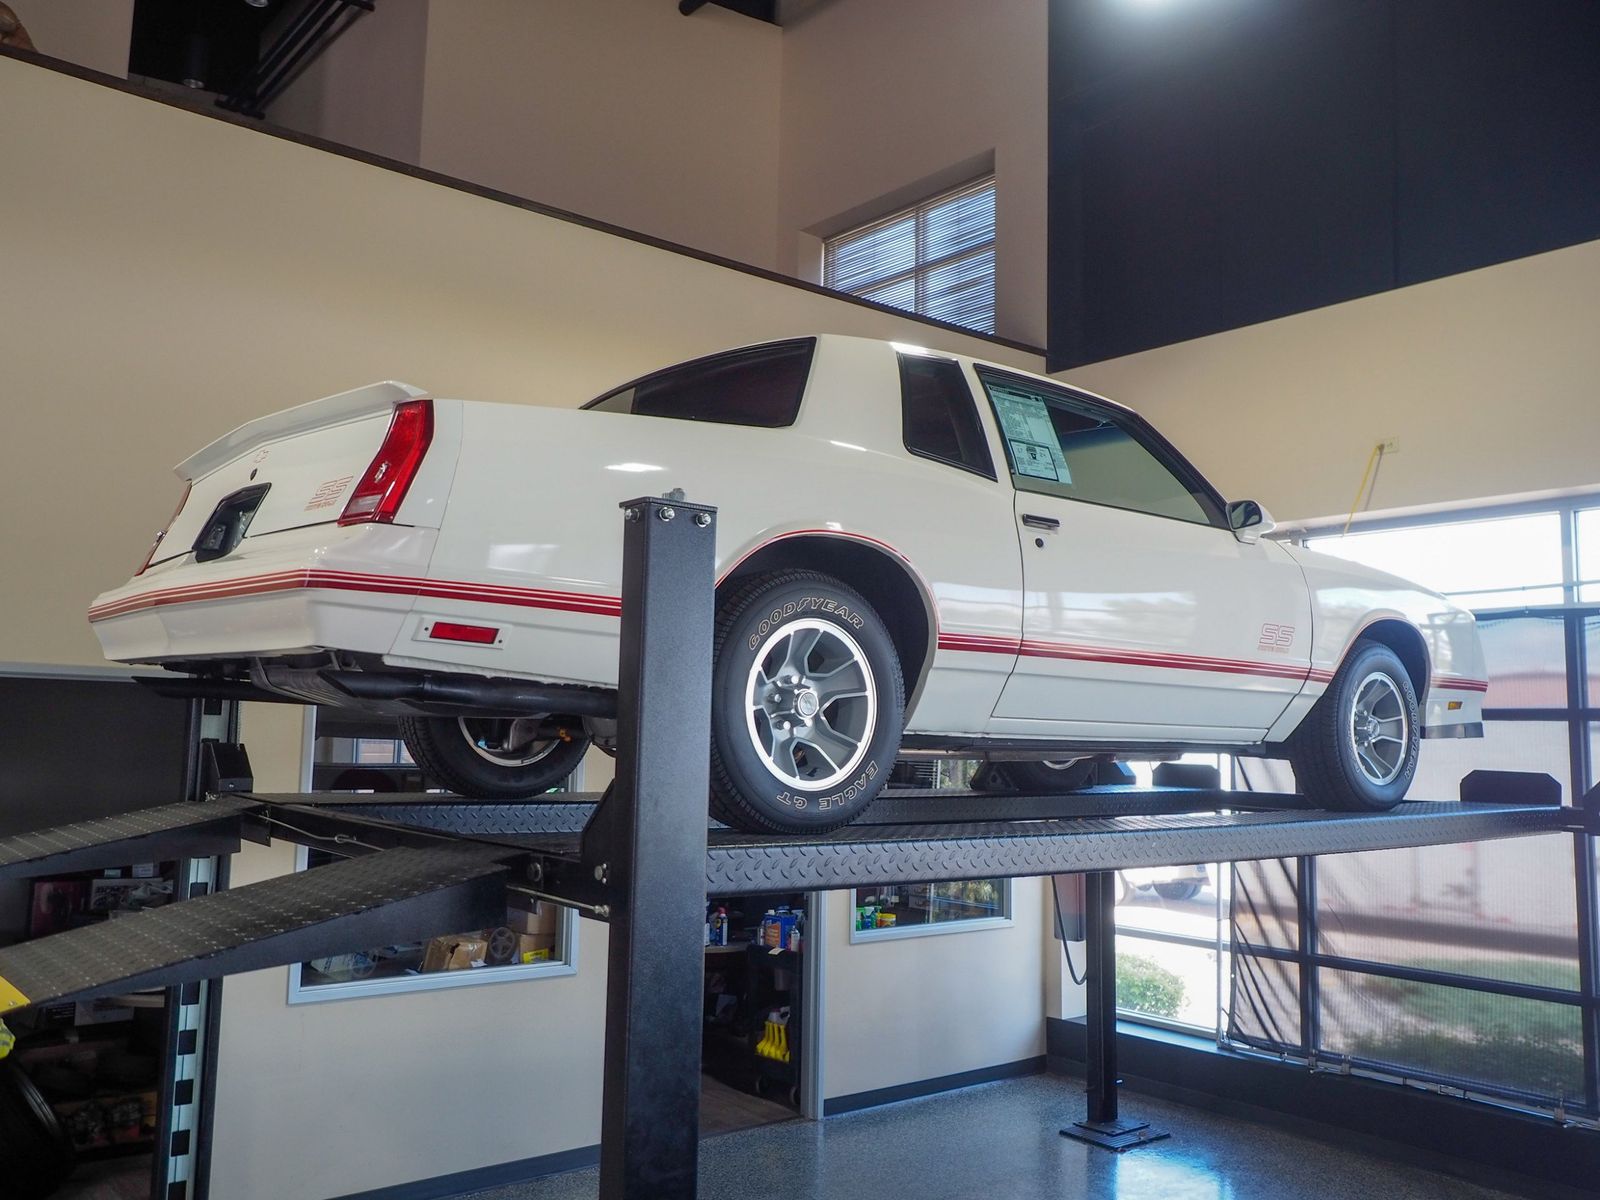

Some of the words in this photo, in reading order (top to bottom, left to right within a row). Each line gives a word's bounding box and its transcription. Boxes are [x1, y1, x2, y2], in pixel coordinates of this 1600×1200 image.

[308, 475, 354, 505] SS
[748, 597, 865, 651] GOODYEAR
[1259, 622, 1296, 647] SS
[1402, 681, 1420, 780] GOODYEAR
[776, 791, 808, 810] GT
[819, 760, 879, 810] EAGLE
